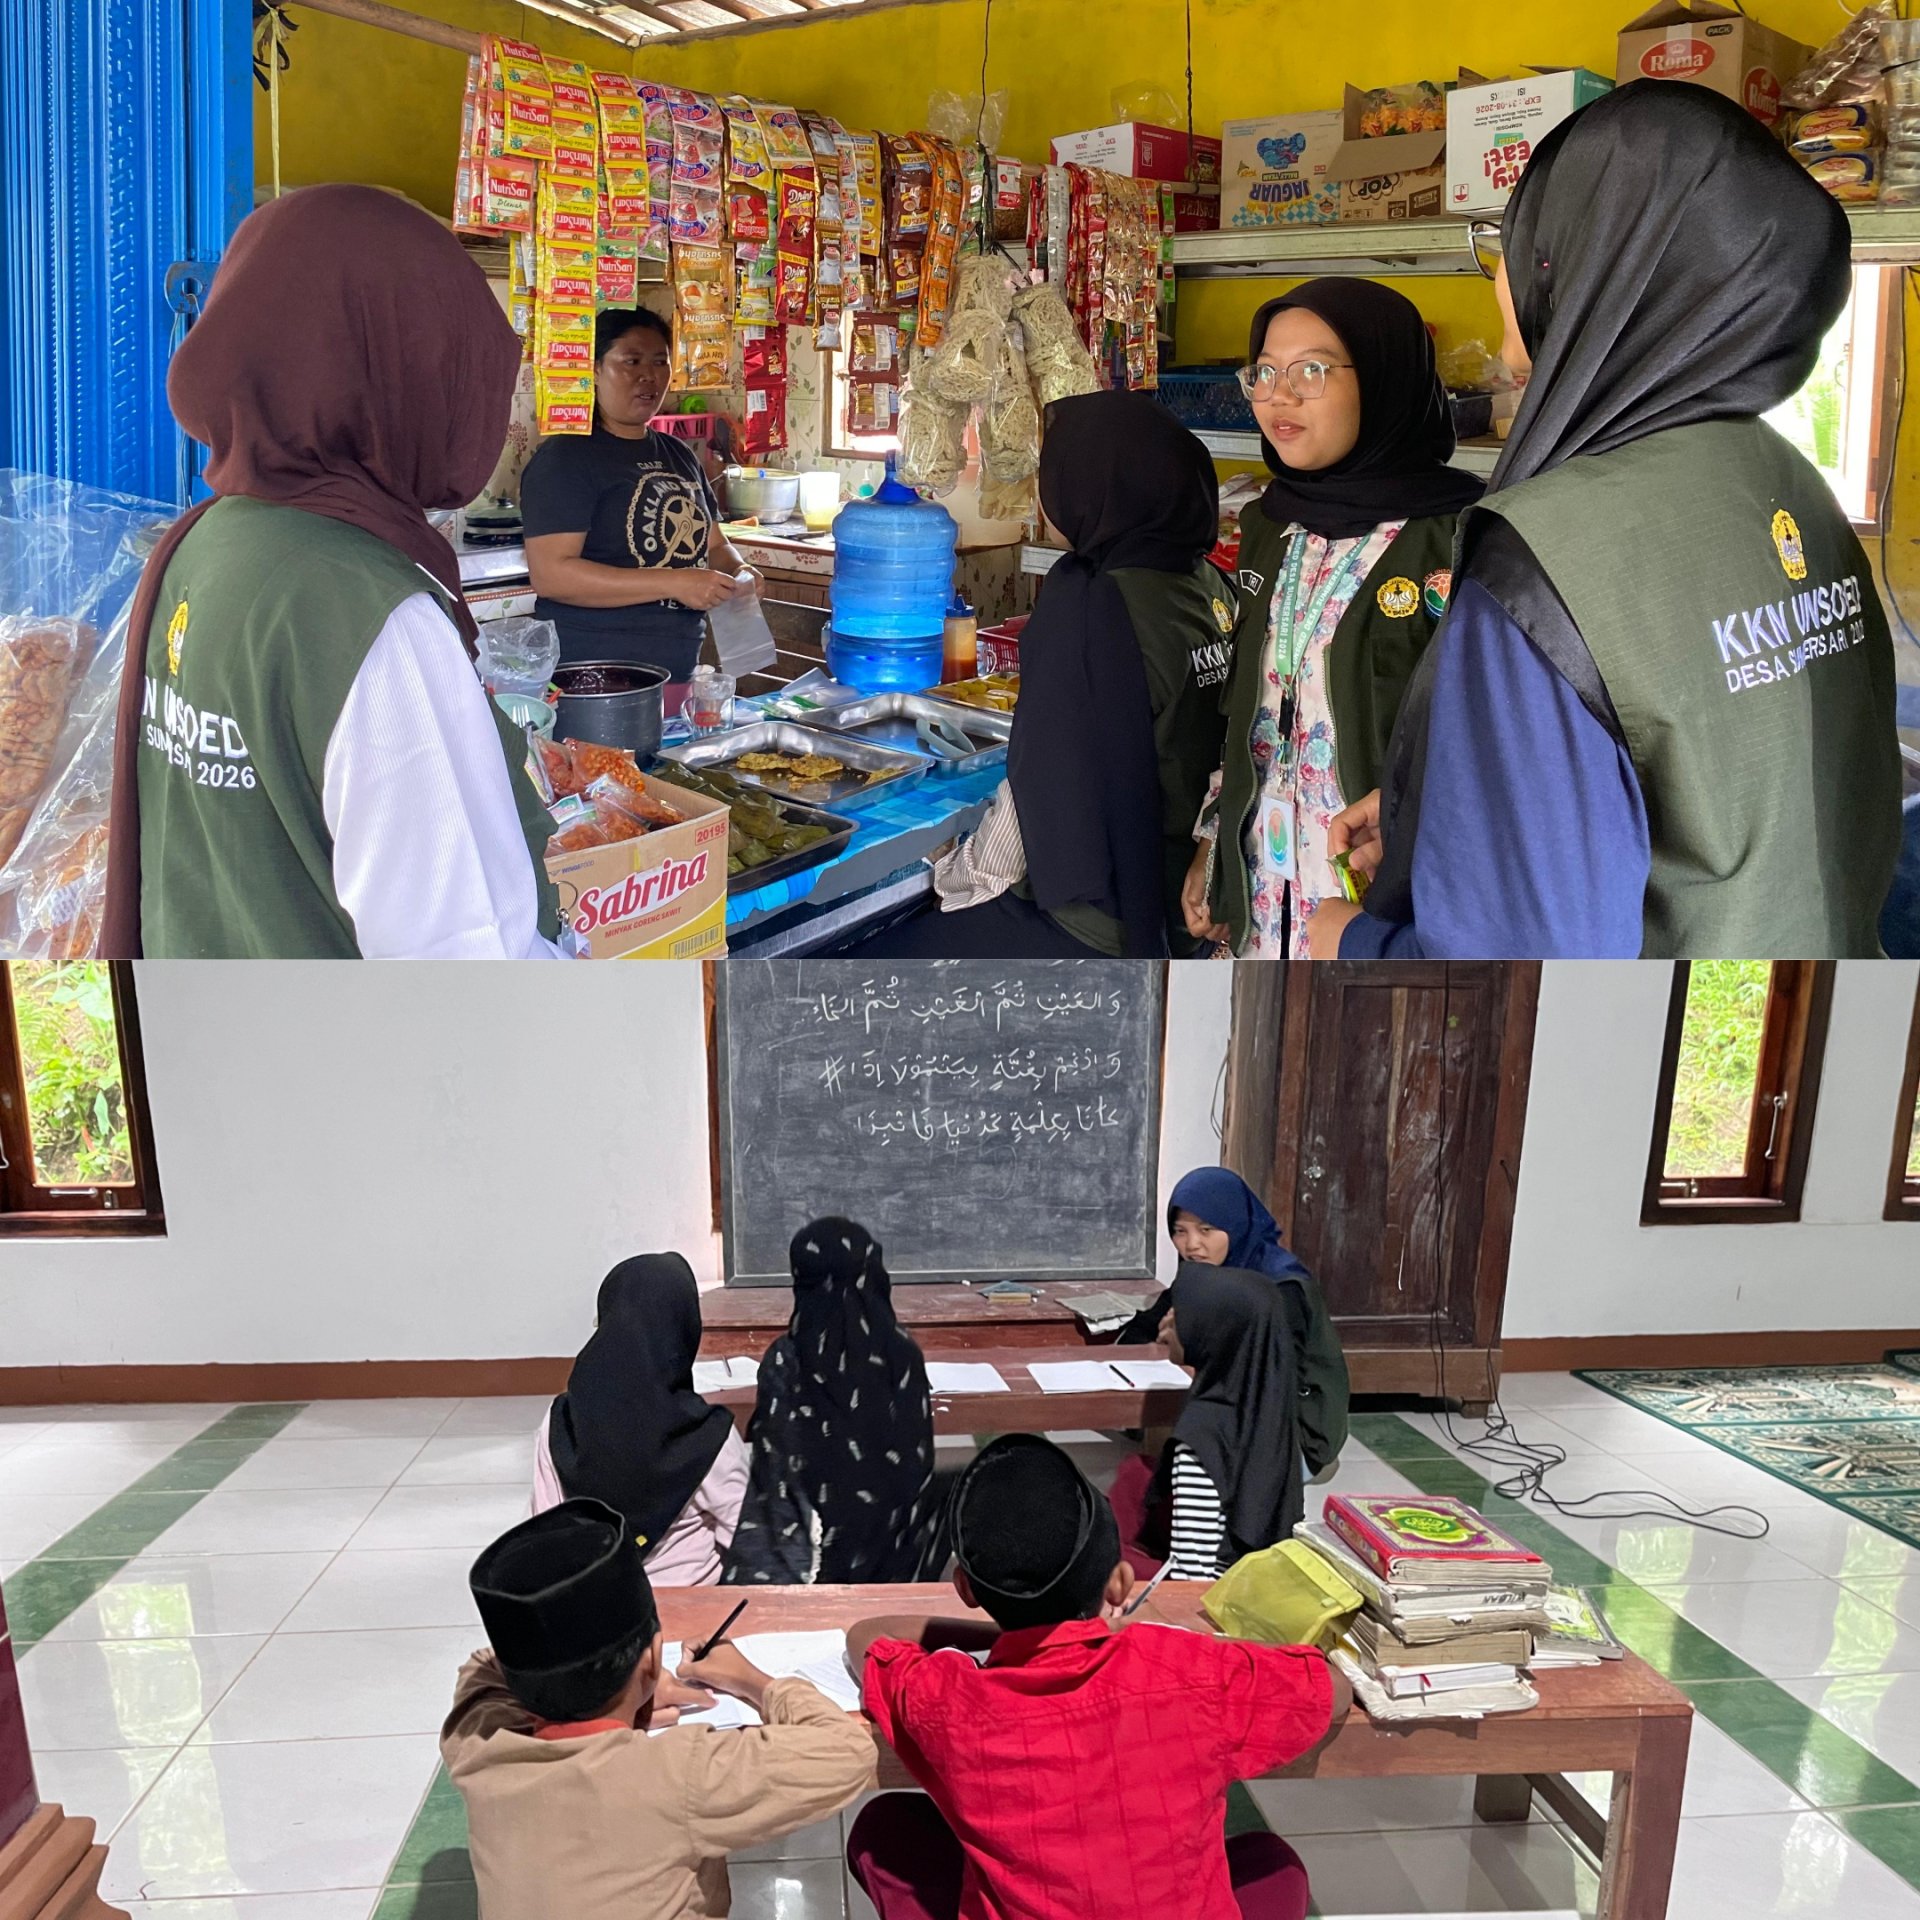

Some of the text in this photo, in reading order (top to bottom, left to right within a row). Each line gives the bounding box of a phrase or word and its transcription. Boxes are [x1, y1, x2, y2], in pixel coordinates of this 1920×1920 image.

[1708, 27, 1730, 35] PACK
[1650, 54, 1704, 72] Roma
[512, 104, 549, 123] NutriSari
[557, 150, 593, 166] NutriSari
[1483, 140, 1531, 176] Eat!
[490, 179, 528, 197] NutriSari
[1493, 163, 1528, 190] ry
[1249, 179, 1311, 204] JAGUAR
[556, 215, 592, 231] NutriSari
[599, 259, 632, 272] NutriSari
[555, 279, 591, 295] NutriSari
[551, 343, 588, 358] NutriSari
[551, 407, 588, 420] NutriSari
[642, 481, 681, 552] OAKLAND
[1304, 608, 1319, 631] DESA
[1316, 557, 1350, 606] SUMBERSARI
[1280, 585, 1296, 637] SUMBERSARI
[1712, 575, 1861, 664] KKN UNSOED
[1192, 642, 1225, 673] KKN
[1725, 655, 1790, 693] DESA
[196, 762, 256, 789] 2026
[696, 823, 727, 843] 20195
[574, 851, 708, 934] Sabrina
[604, 906, 682, 938] MINYAK GORENG SAWIT
